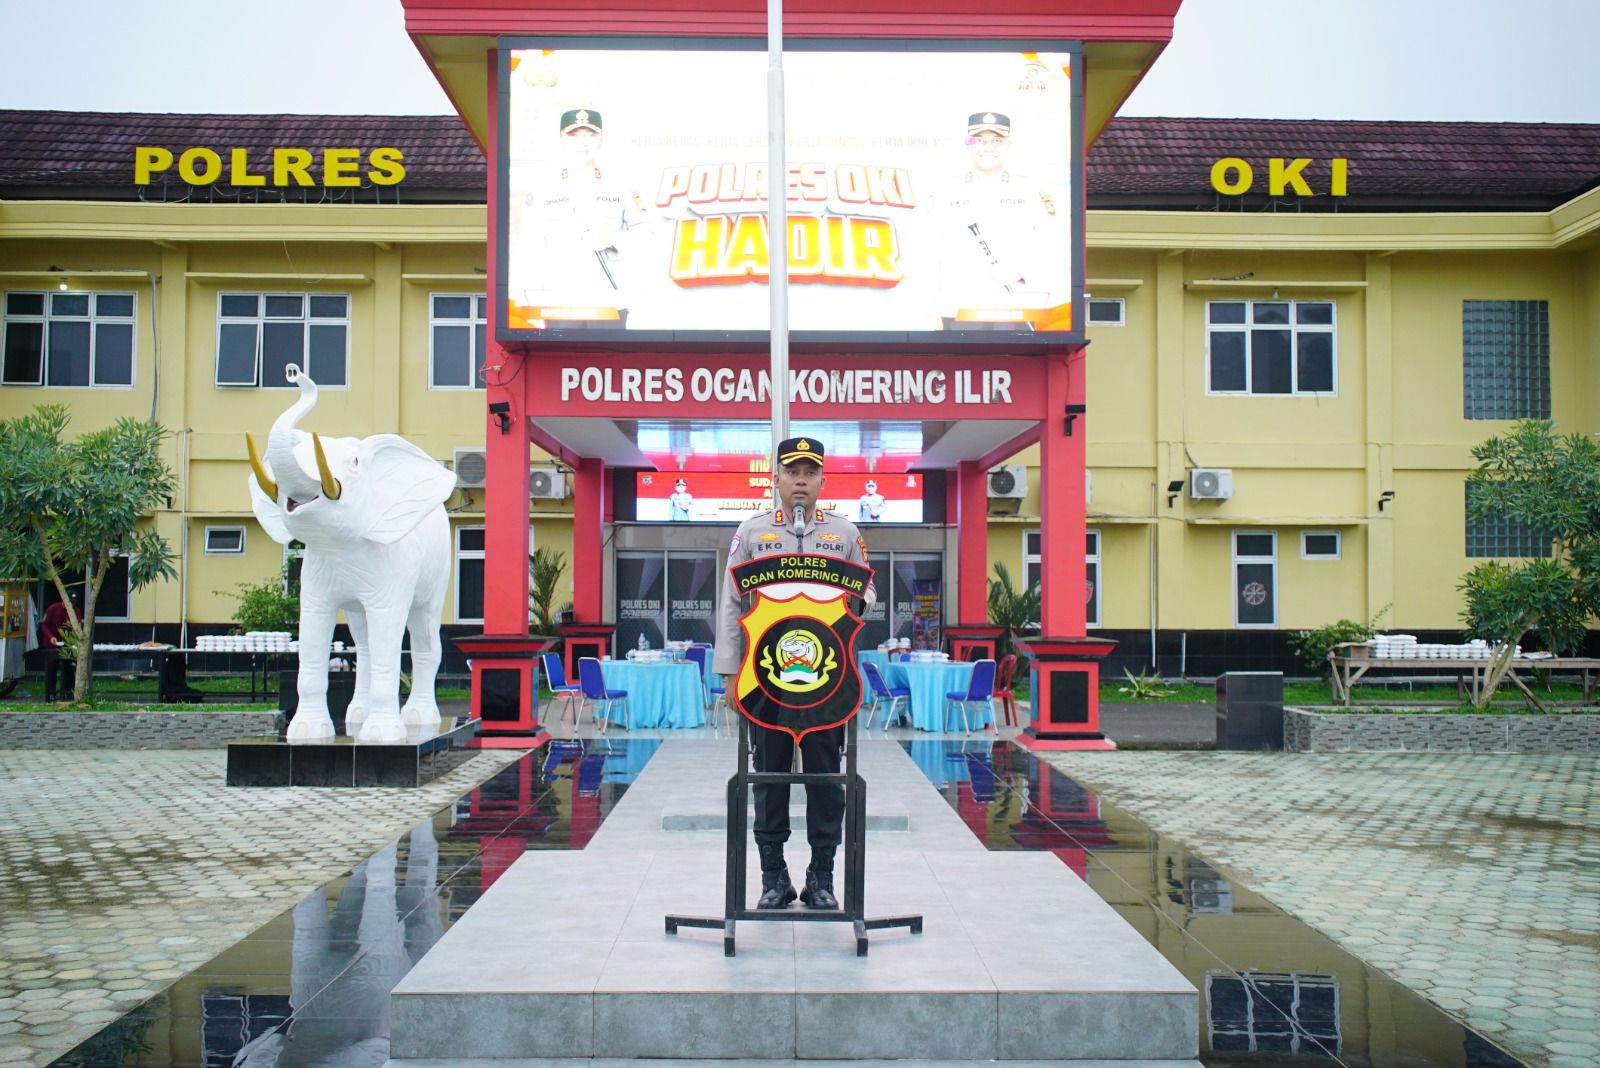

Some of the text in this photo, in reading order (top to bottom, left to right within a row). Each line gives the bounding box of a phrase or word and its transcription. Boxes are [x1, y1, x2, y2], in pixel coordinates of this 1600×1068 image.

[134, 147, 1347, 196] POLRES OKI
[655, 162, 916, 209] POLRES OKI
[671, 213, 903, 286] HADIR
[561, 366, 1012, 404] POLRES OGAN KOMERING ILIR
[758, 542, 783, 551] EKO
[816, 543, 844, 552] POLRI
[780, 556, 827, 568] POLRES
[741, 569, 863, 591] OGAN KOMERING ILIR
[621, 600, 660, 609] POLRES OKI
[673, 600, 712, 610] POLRES OKI
